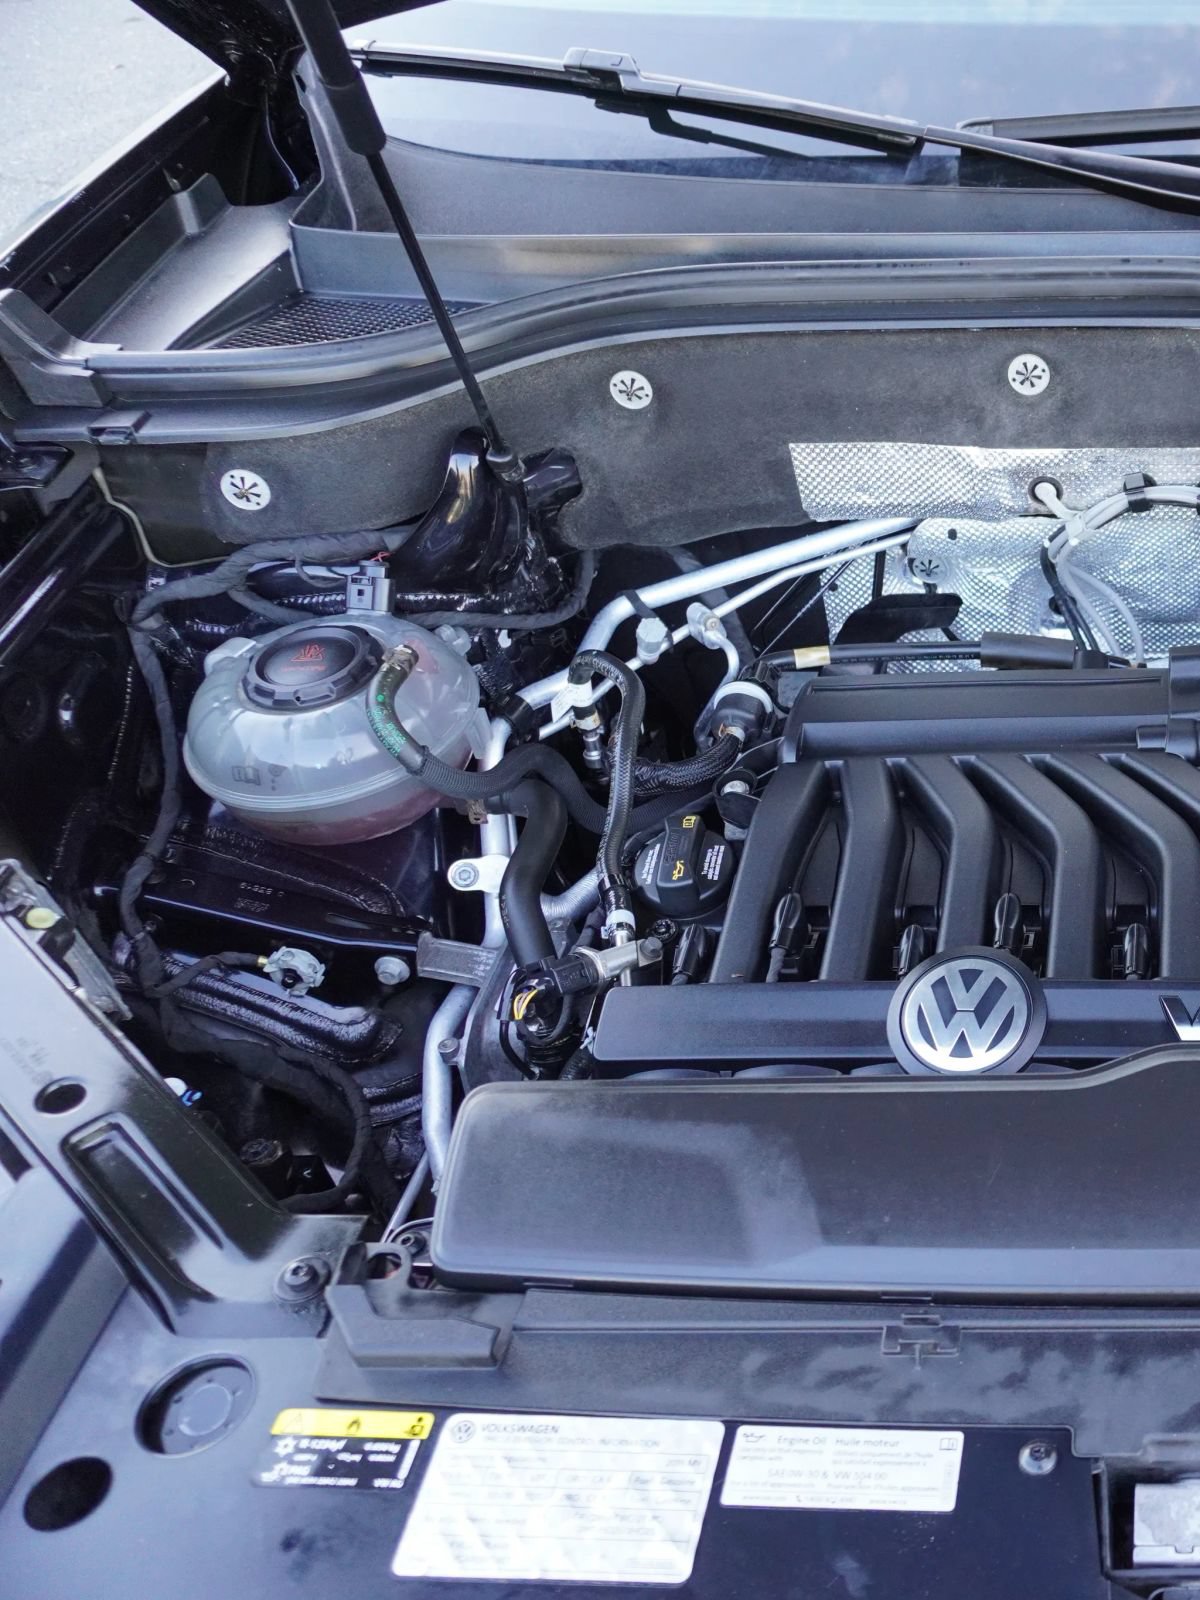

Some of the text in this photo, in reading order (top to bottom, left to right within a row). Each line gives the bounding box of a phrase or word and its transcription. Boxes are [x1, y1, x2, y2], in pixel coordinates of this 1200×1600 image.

[481, 1423, 560, 1435] VOLKSWAGEN
[777, 1435, 827, 1447] Engine Oil
[836, 1438, 900, 1448] Huile moteur
